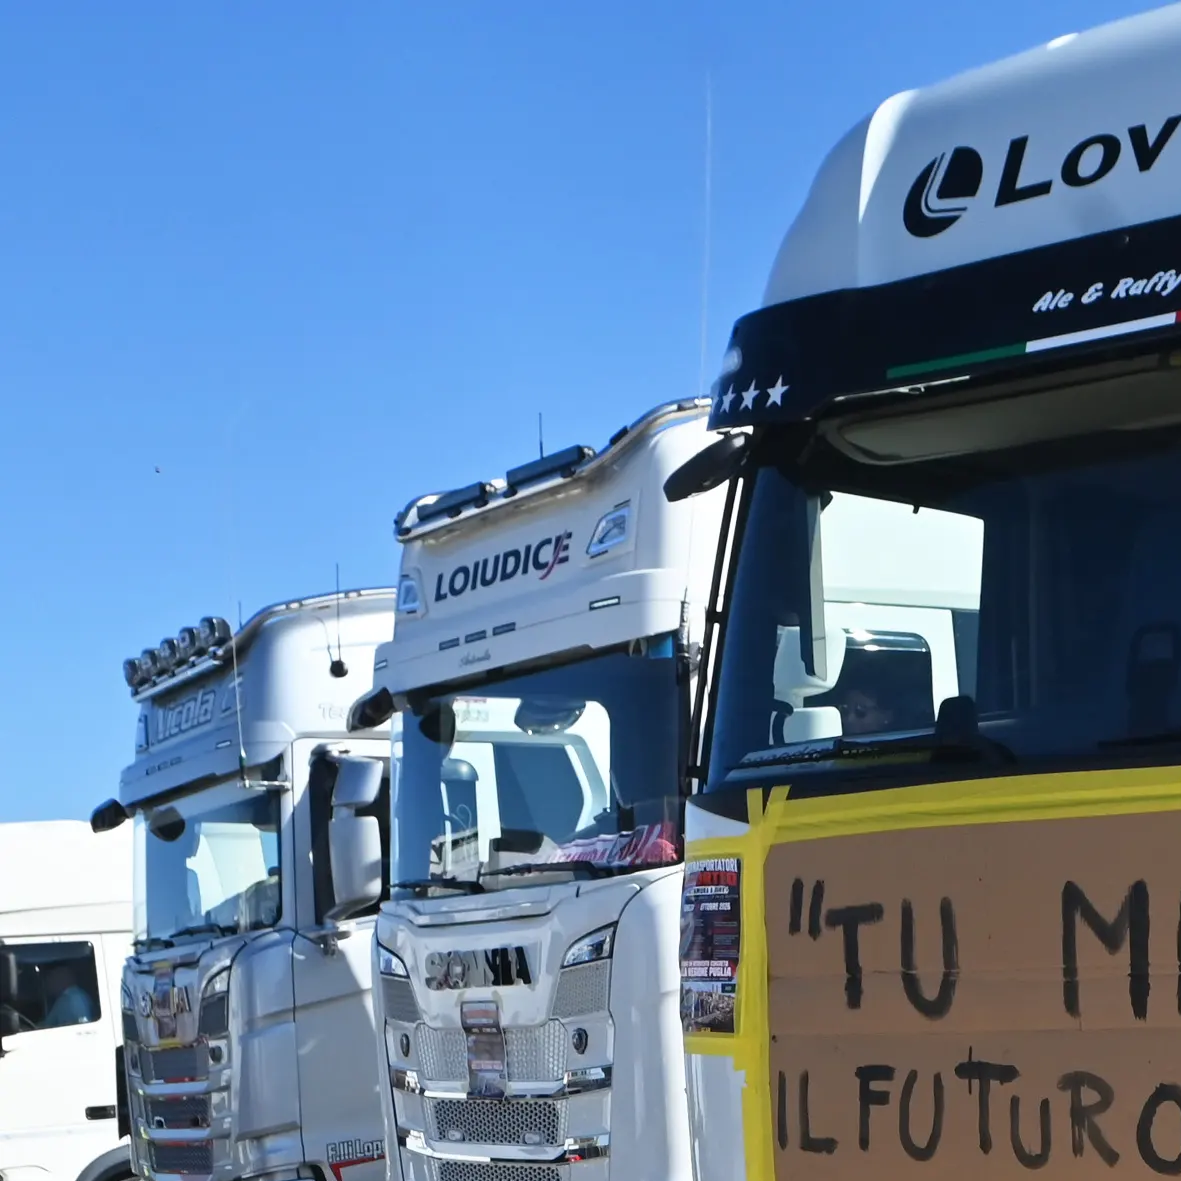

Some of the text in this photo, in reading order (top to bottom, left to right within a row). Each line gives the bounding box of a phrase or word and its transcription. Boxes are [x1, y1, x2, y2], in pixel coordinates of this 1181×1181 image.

[1032, 288, 1074, 312] Ale
[1081, 282, 1104, 304] &
[434, 531, 572, 601] LOIUDICE
[778, 1069, 839, 1154] IL
